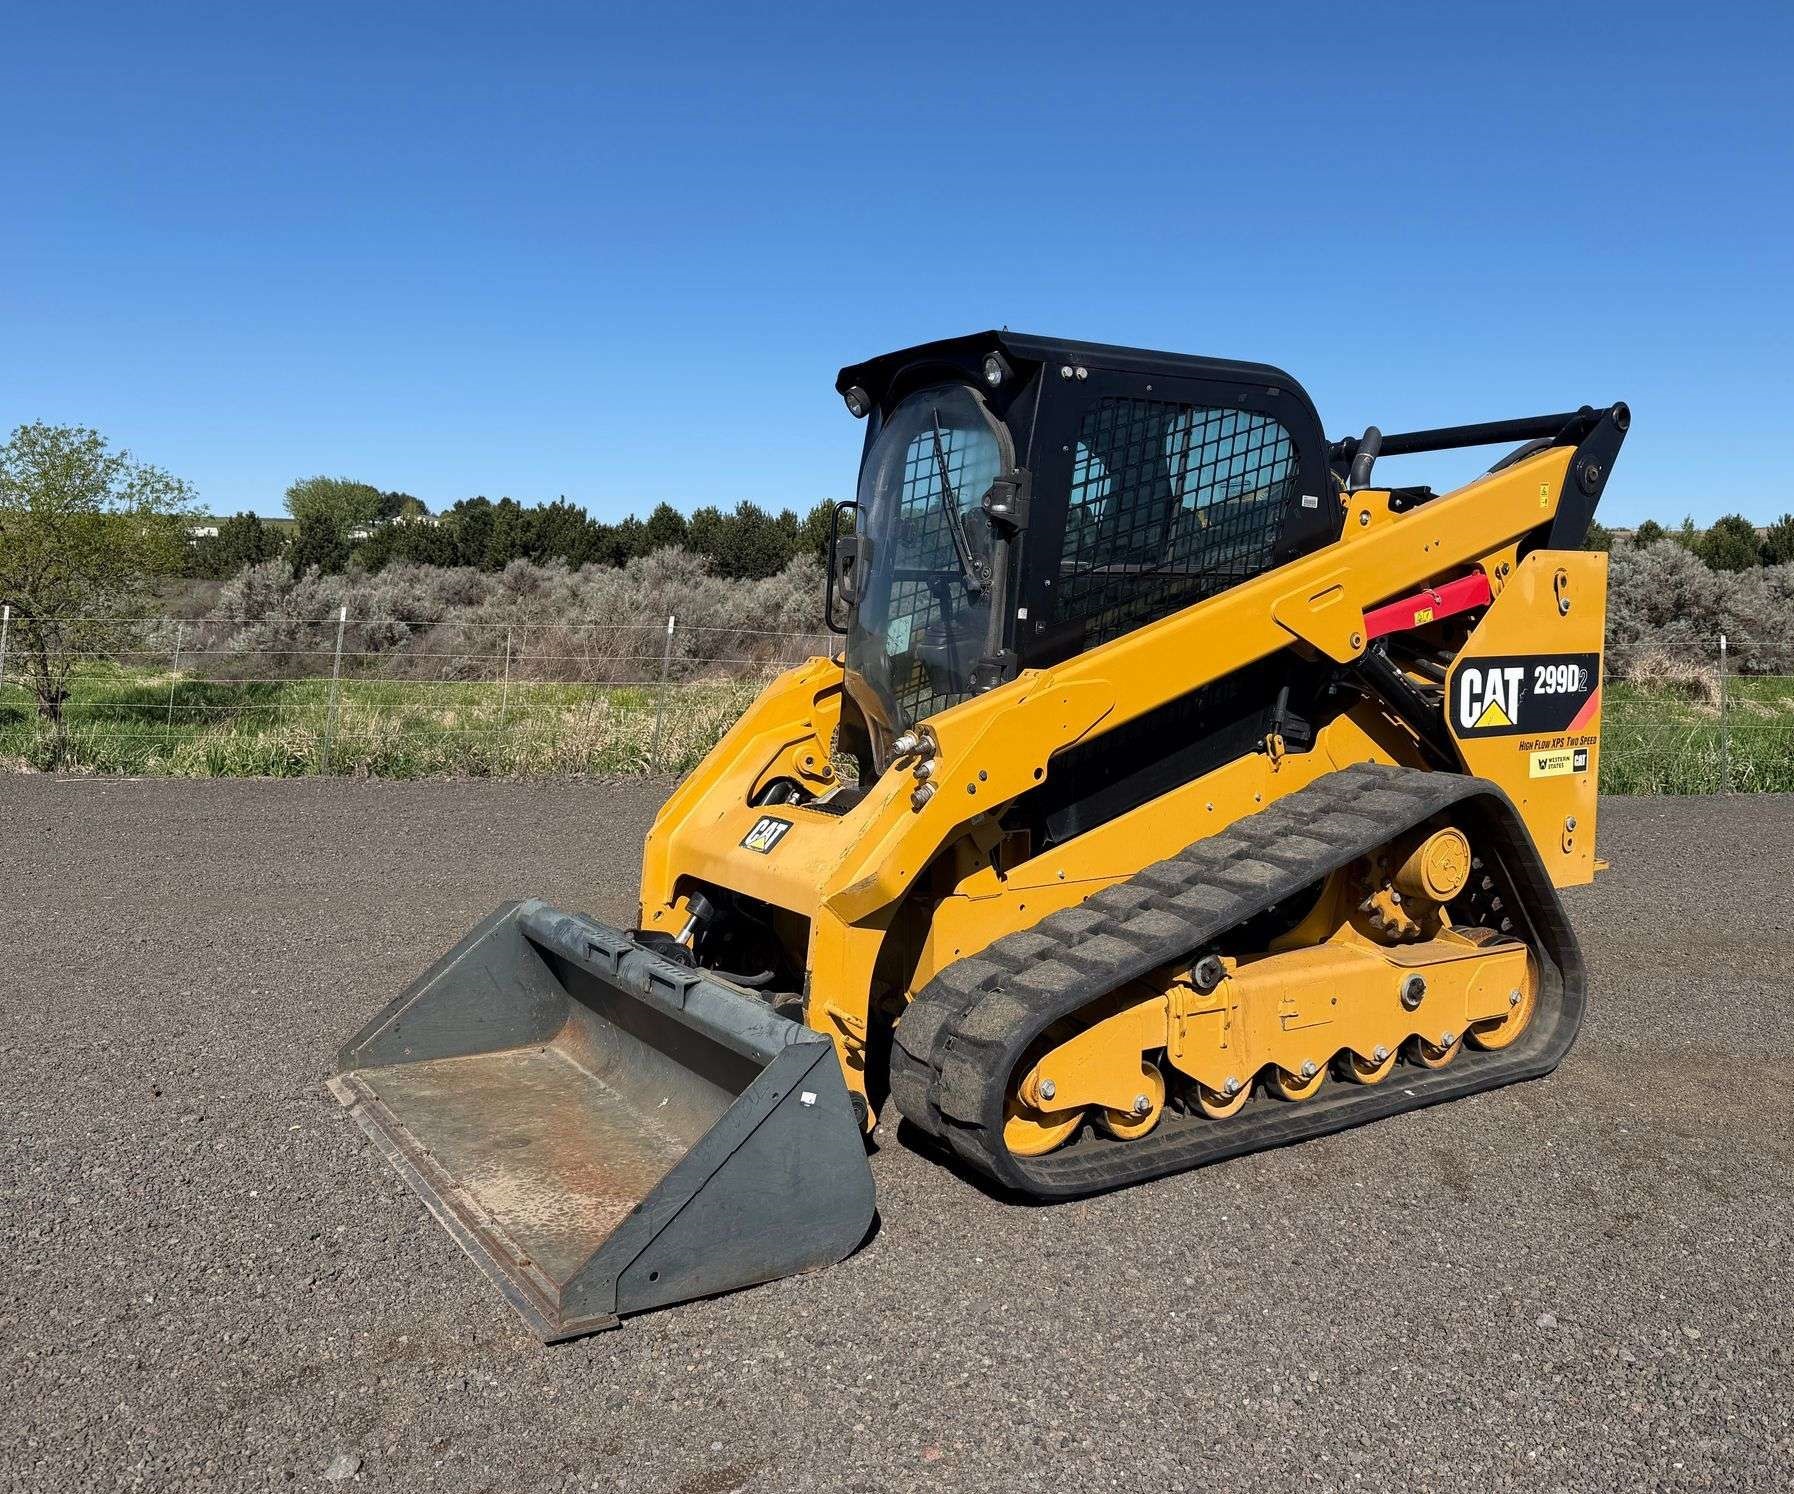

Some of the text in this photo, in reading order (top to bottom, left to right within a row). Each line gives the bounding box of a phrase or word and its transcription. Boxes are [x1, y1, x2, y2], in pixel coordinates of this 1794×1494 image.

[1460, 664, 1588, 729] CAT 299D2
[1551, 737, 1565, 748] XPS
[1574, 755, 1586, 766] CAT
[744, 819, 789, 850] CAT
